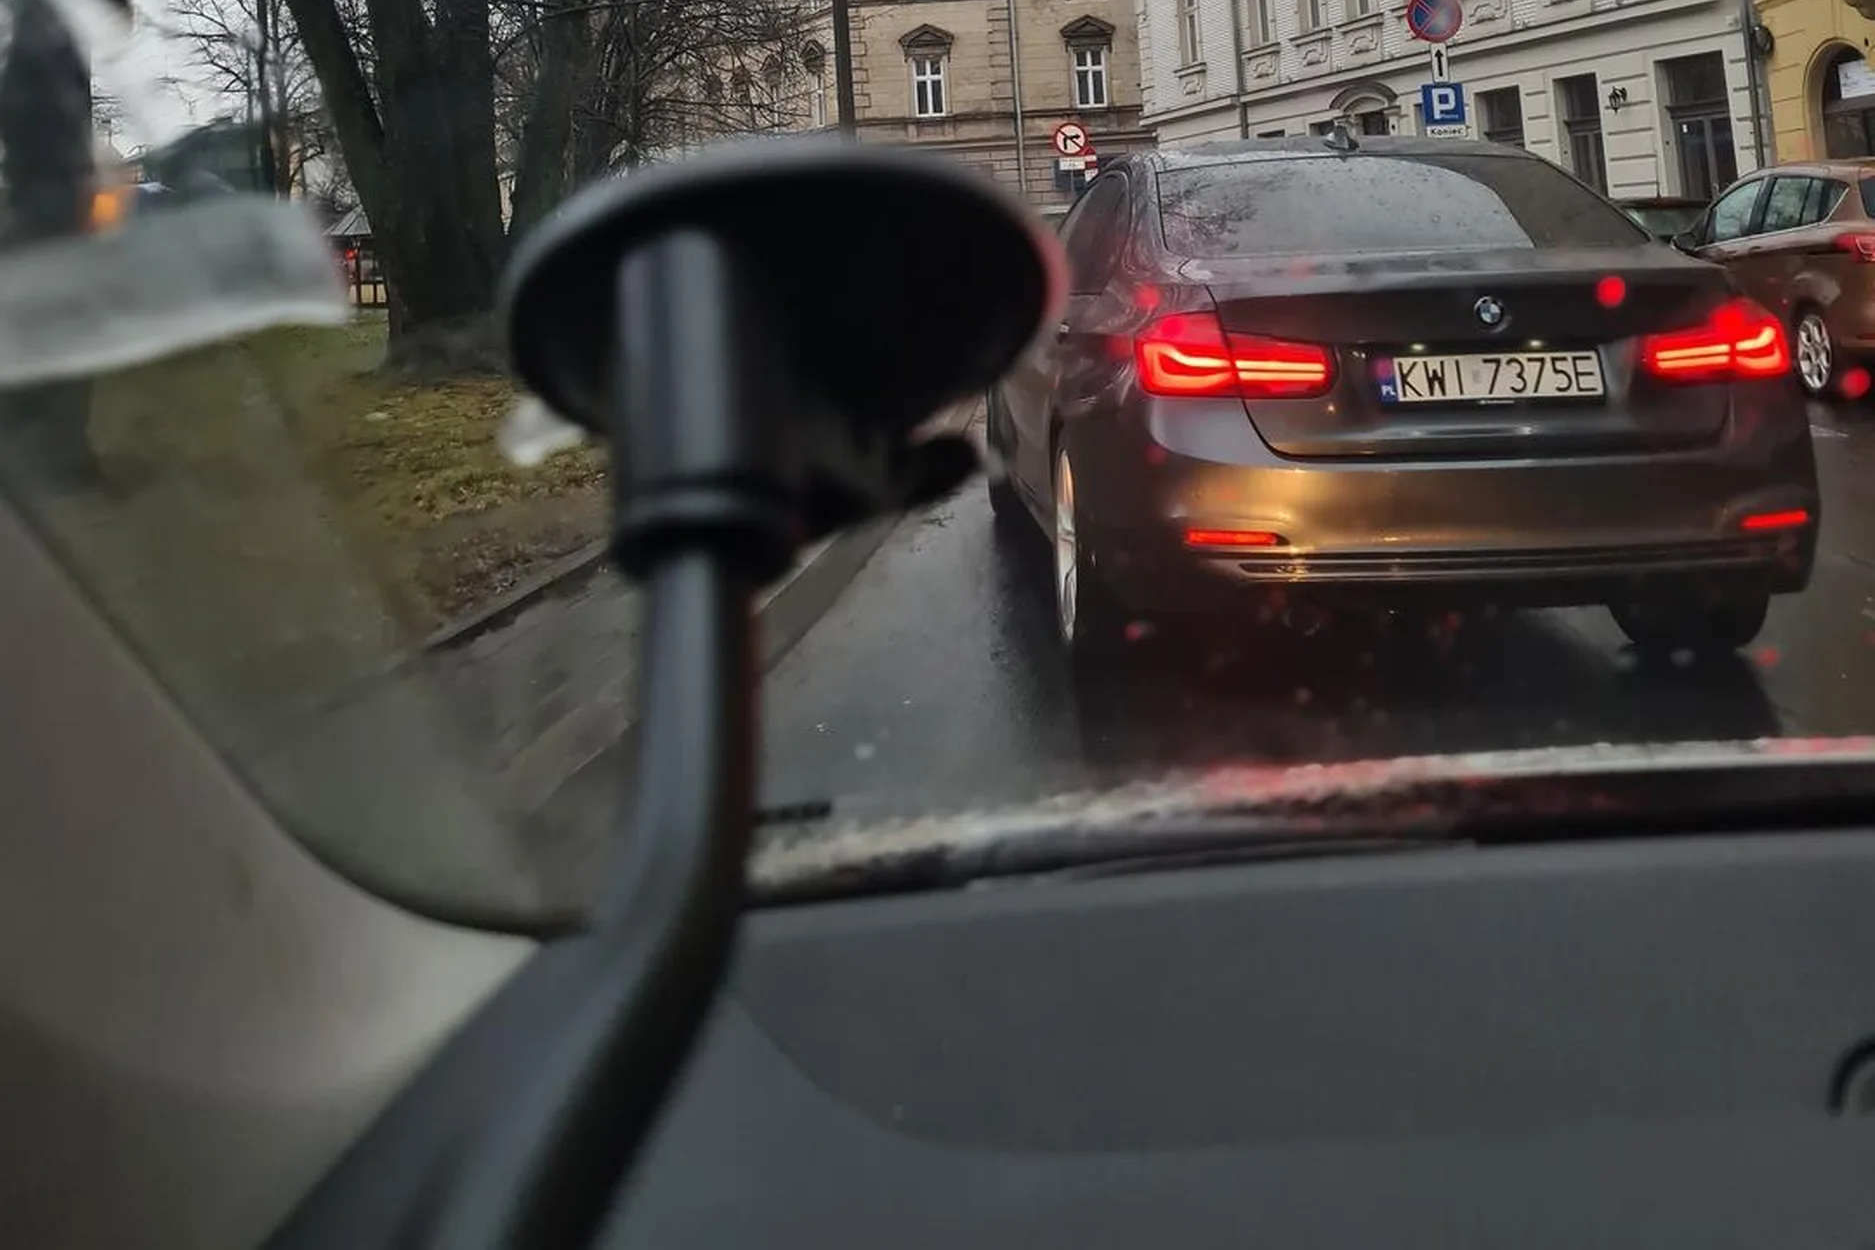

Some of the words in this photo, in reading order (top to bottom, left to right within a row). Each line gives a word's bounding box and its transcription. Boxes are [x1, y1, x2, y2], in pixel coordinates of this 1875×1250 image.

[1432, 88, 1456, 119] P
[1431, 128, 1463, 136] Koniec
[1398, 359, 1463, 397] KWI
[1482, 356, 1598, 395] 7375E
[1381, 385, 1396, 396] PL
